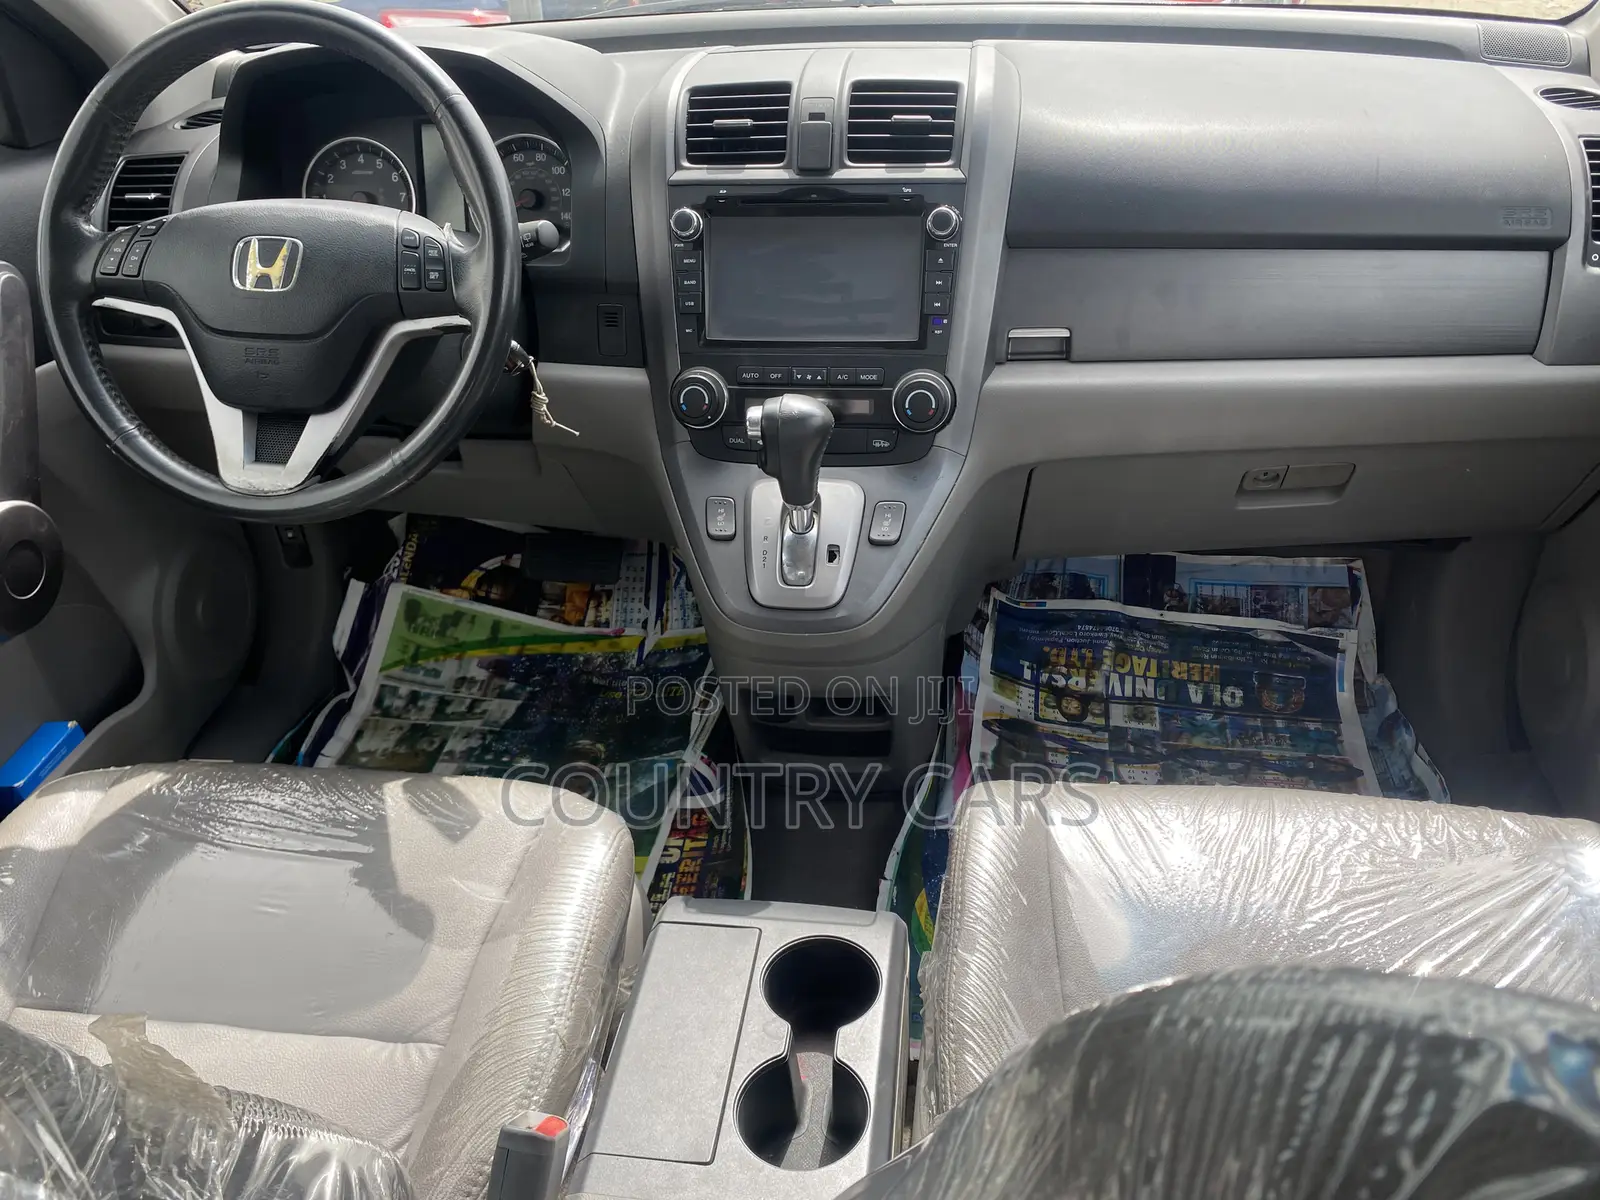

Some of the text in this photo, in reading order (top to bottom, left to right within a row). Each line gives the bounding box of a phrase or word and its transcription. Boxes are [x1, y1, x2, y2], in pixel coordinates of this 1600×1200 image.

[357, 153, 365, 164] 4
[513, 153, 524, 162] 60
[535, 153, 546, 162] 80
[339, 160, 347, 169] 3
[375, 159, 383, 169] 5
[551, 166, 565, 175] 100
[327, 174, 334, 183] 2
[391, 172, 399, 182] 6
[1187, 683, 1245, 709] OLA
